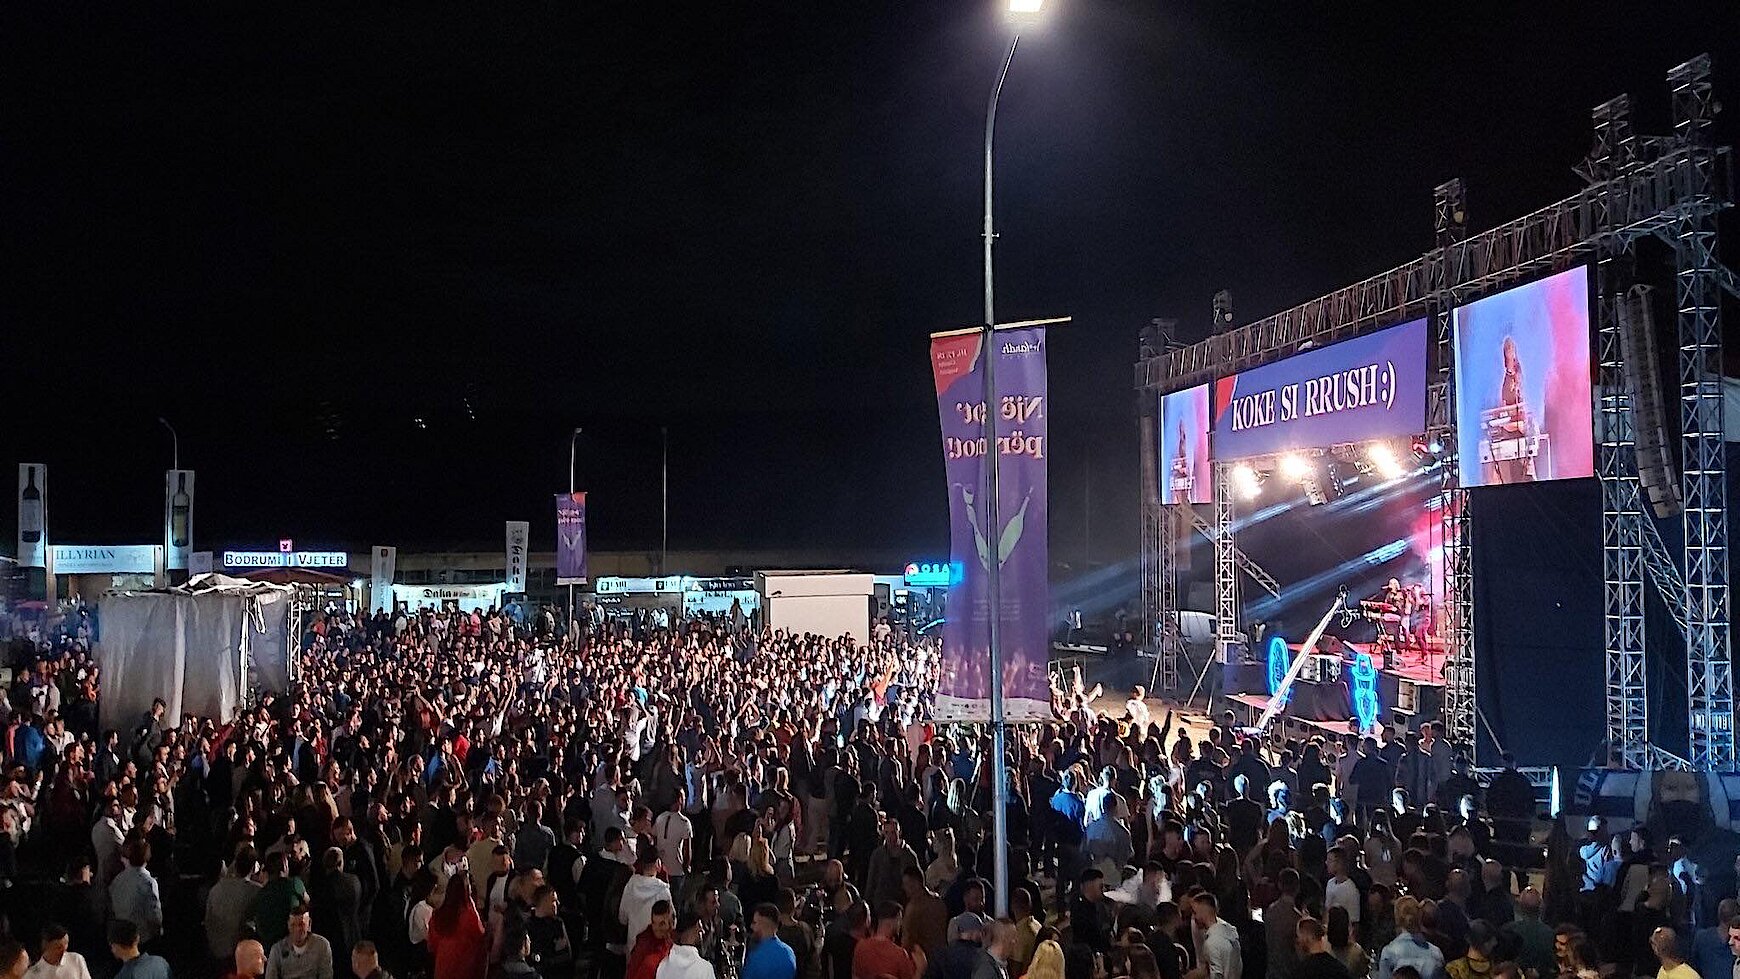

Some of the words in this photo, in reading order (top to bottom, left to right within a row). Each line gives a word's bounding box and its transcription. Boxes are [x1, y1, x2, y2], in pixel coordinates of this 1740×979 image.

[1232, 390, 1275, 431] KOKE
[1281, 384, 1299, 422] SI
[1304, 364, 1378, 417] RRUSH
[56, 549, 115, 560] ILLYRIAN
